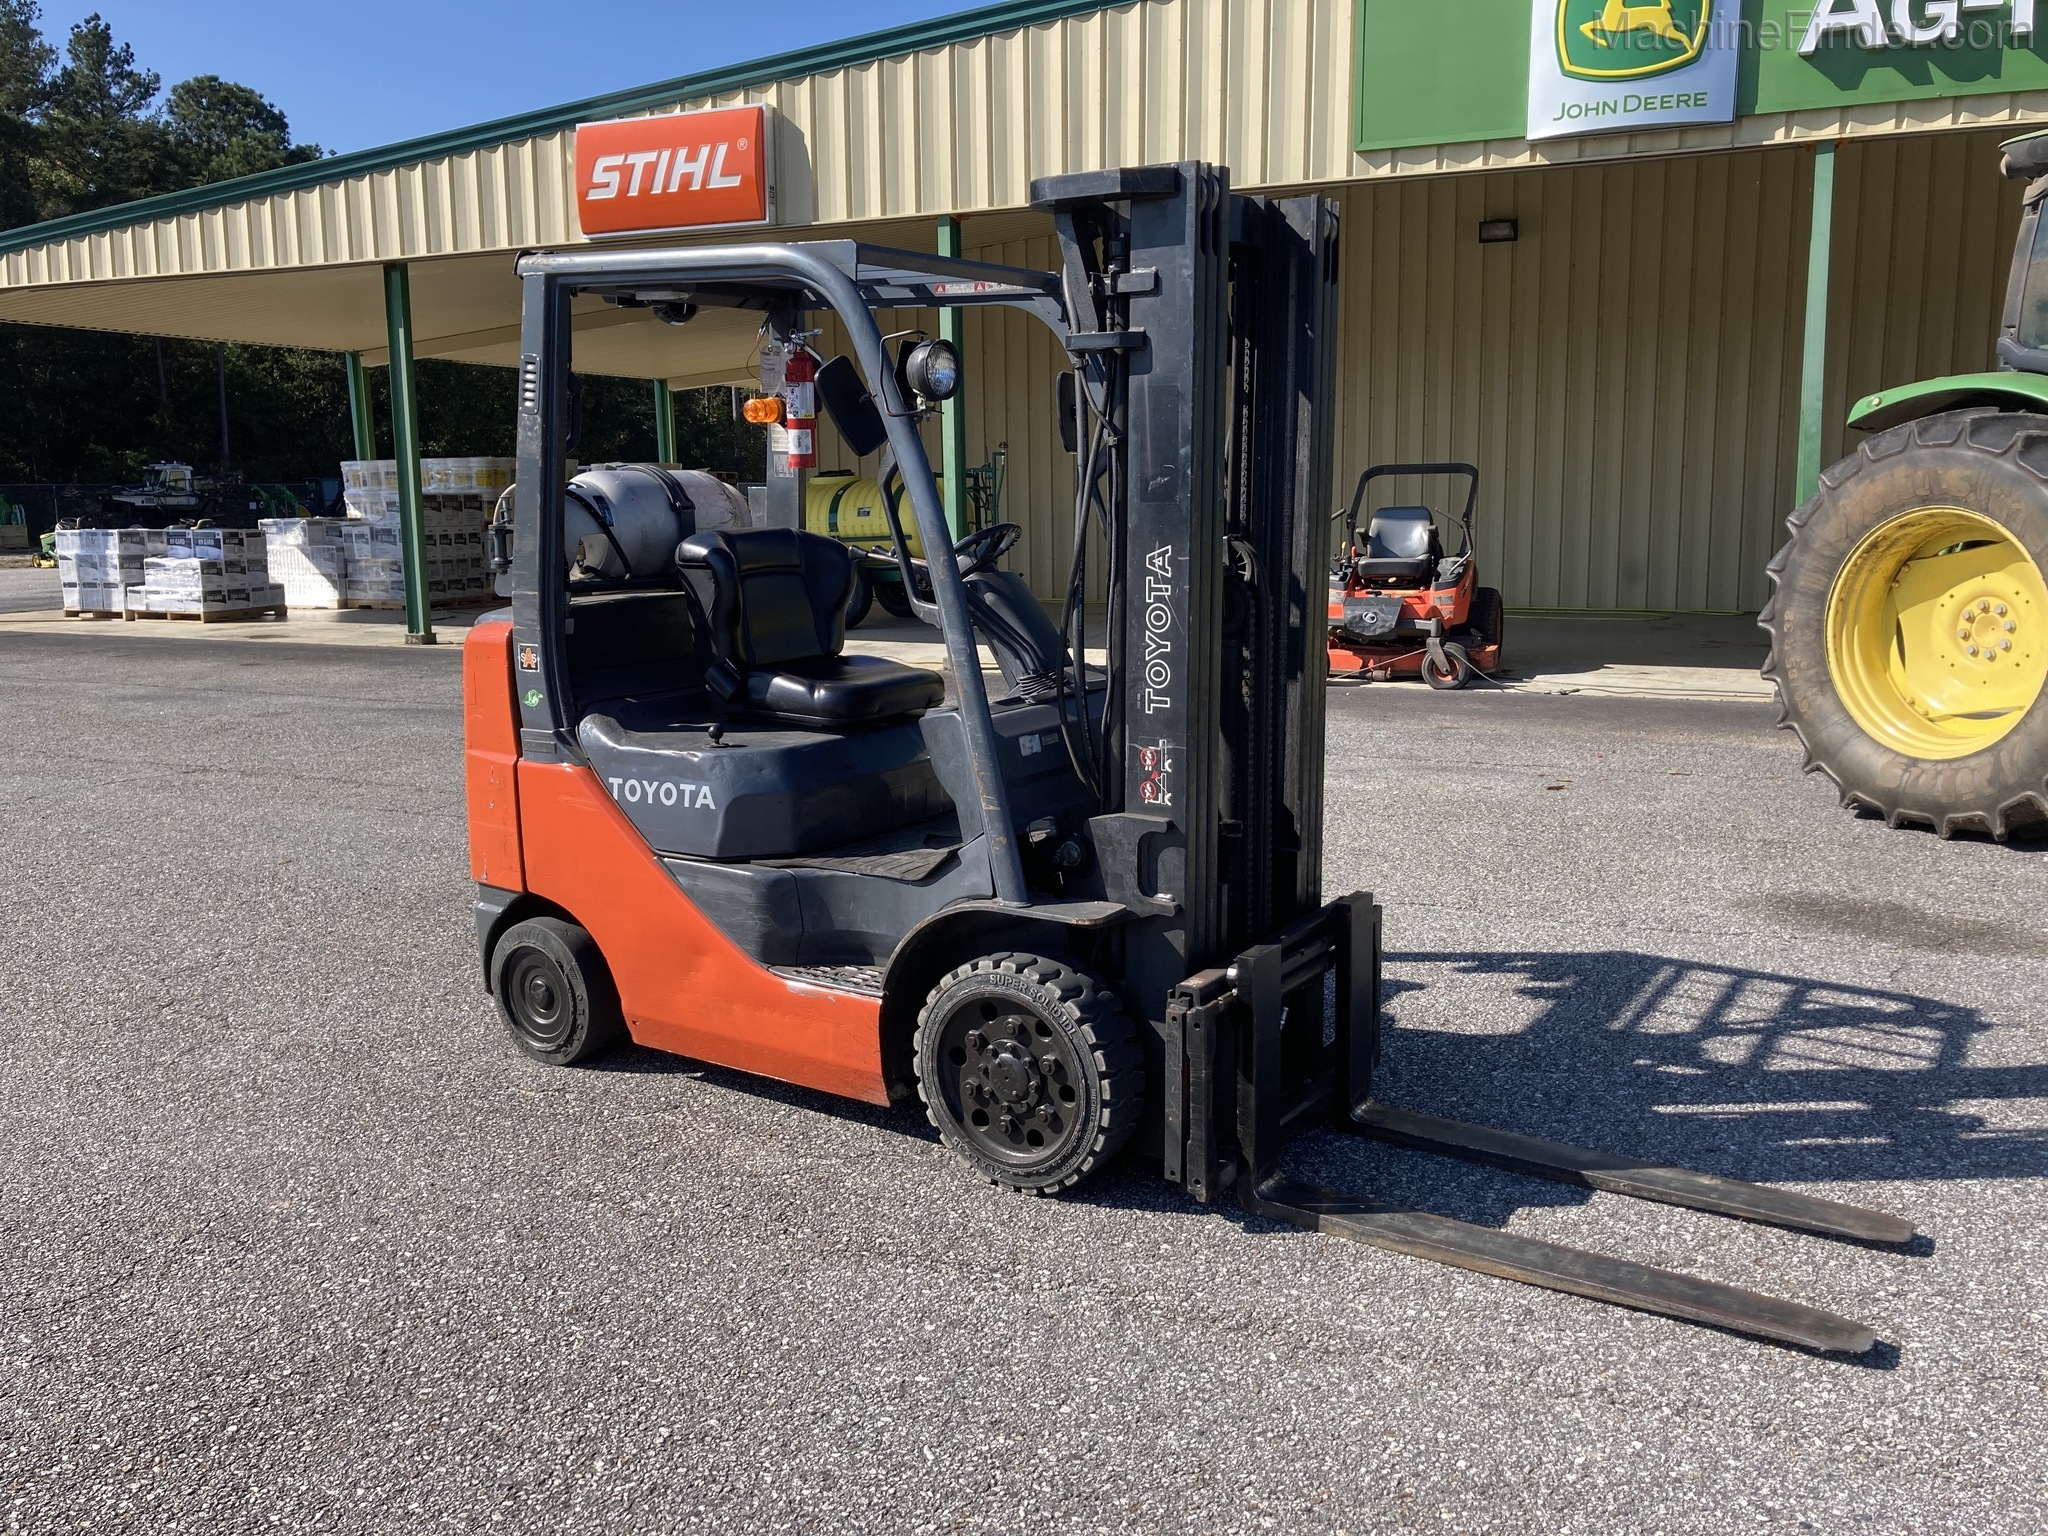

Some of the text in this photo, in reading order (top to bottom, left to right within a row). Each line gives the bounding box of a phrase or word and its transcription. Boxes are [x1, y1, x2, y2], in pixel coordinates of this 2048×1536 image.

[1552, 91, 1708, 121] JOHN DEERE
[586, 142, 742, 200] STIHL
[1145, 544, 1172, 714] TOYOTA
[608, 777, 716, 810] TOYOTA
[990, 974, 1029, 994] SUPER
[1029, 987, 1063, 1018] SOLID
